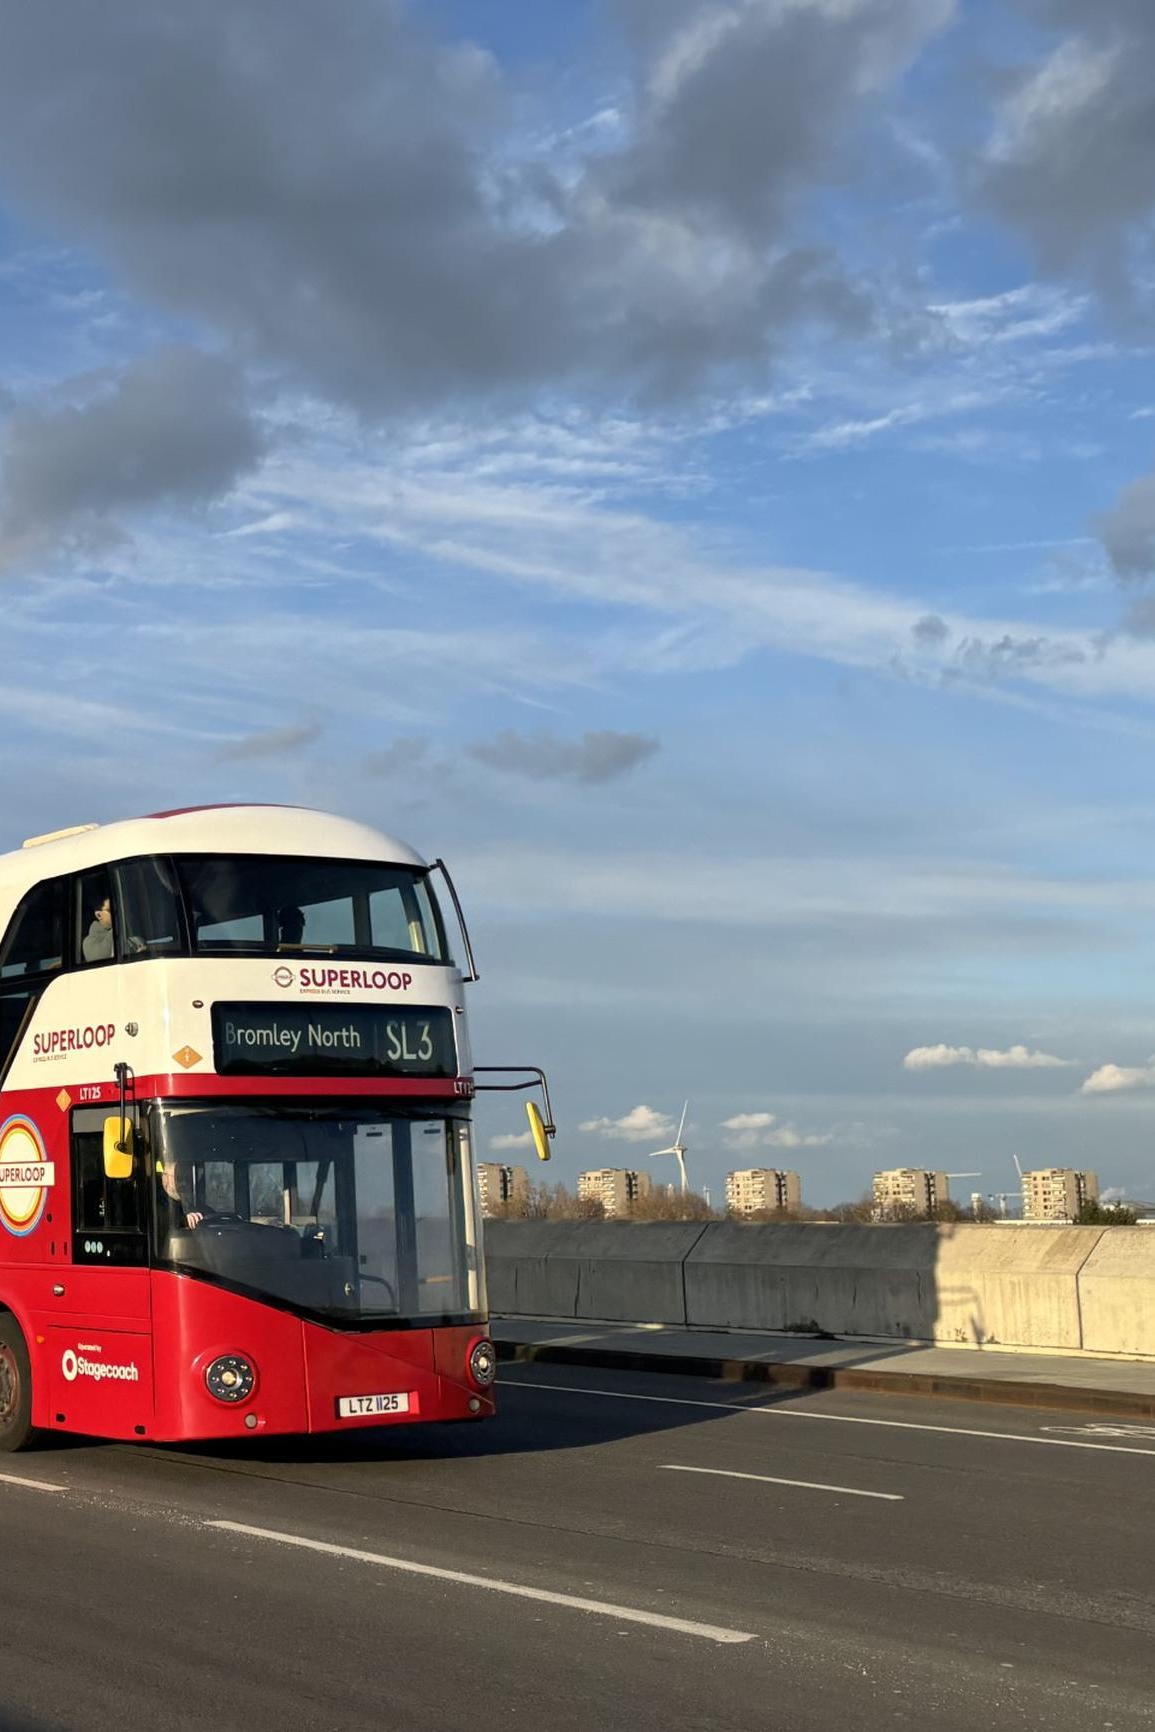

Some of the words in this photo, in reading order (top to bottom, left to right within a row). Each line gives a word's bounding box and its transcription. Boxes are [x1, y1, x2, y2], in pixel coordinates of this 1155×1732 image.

[299, 967, 412, 990] SUPERLOOP
[33, 1023, 116, 1055] SUPERLOOP
[225, 1021, 302, 1053] Bromley
[308, 1022, 361, 1048] North
[386, 1019, 434, 1062] SL3
[79, 1086, 102, 1101] LT125
[77, 1356, 139, 1381] Stagecoach
[349, 1397, 374, 1414] LTZ
[376, 1395, 399, 1412] 1125
